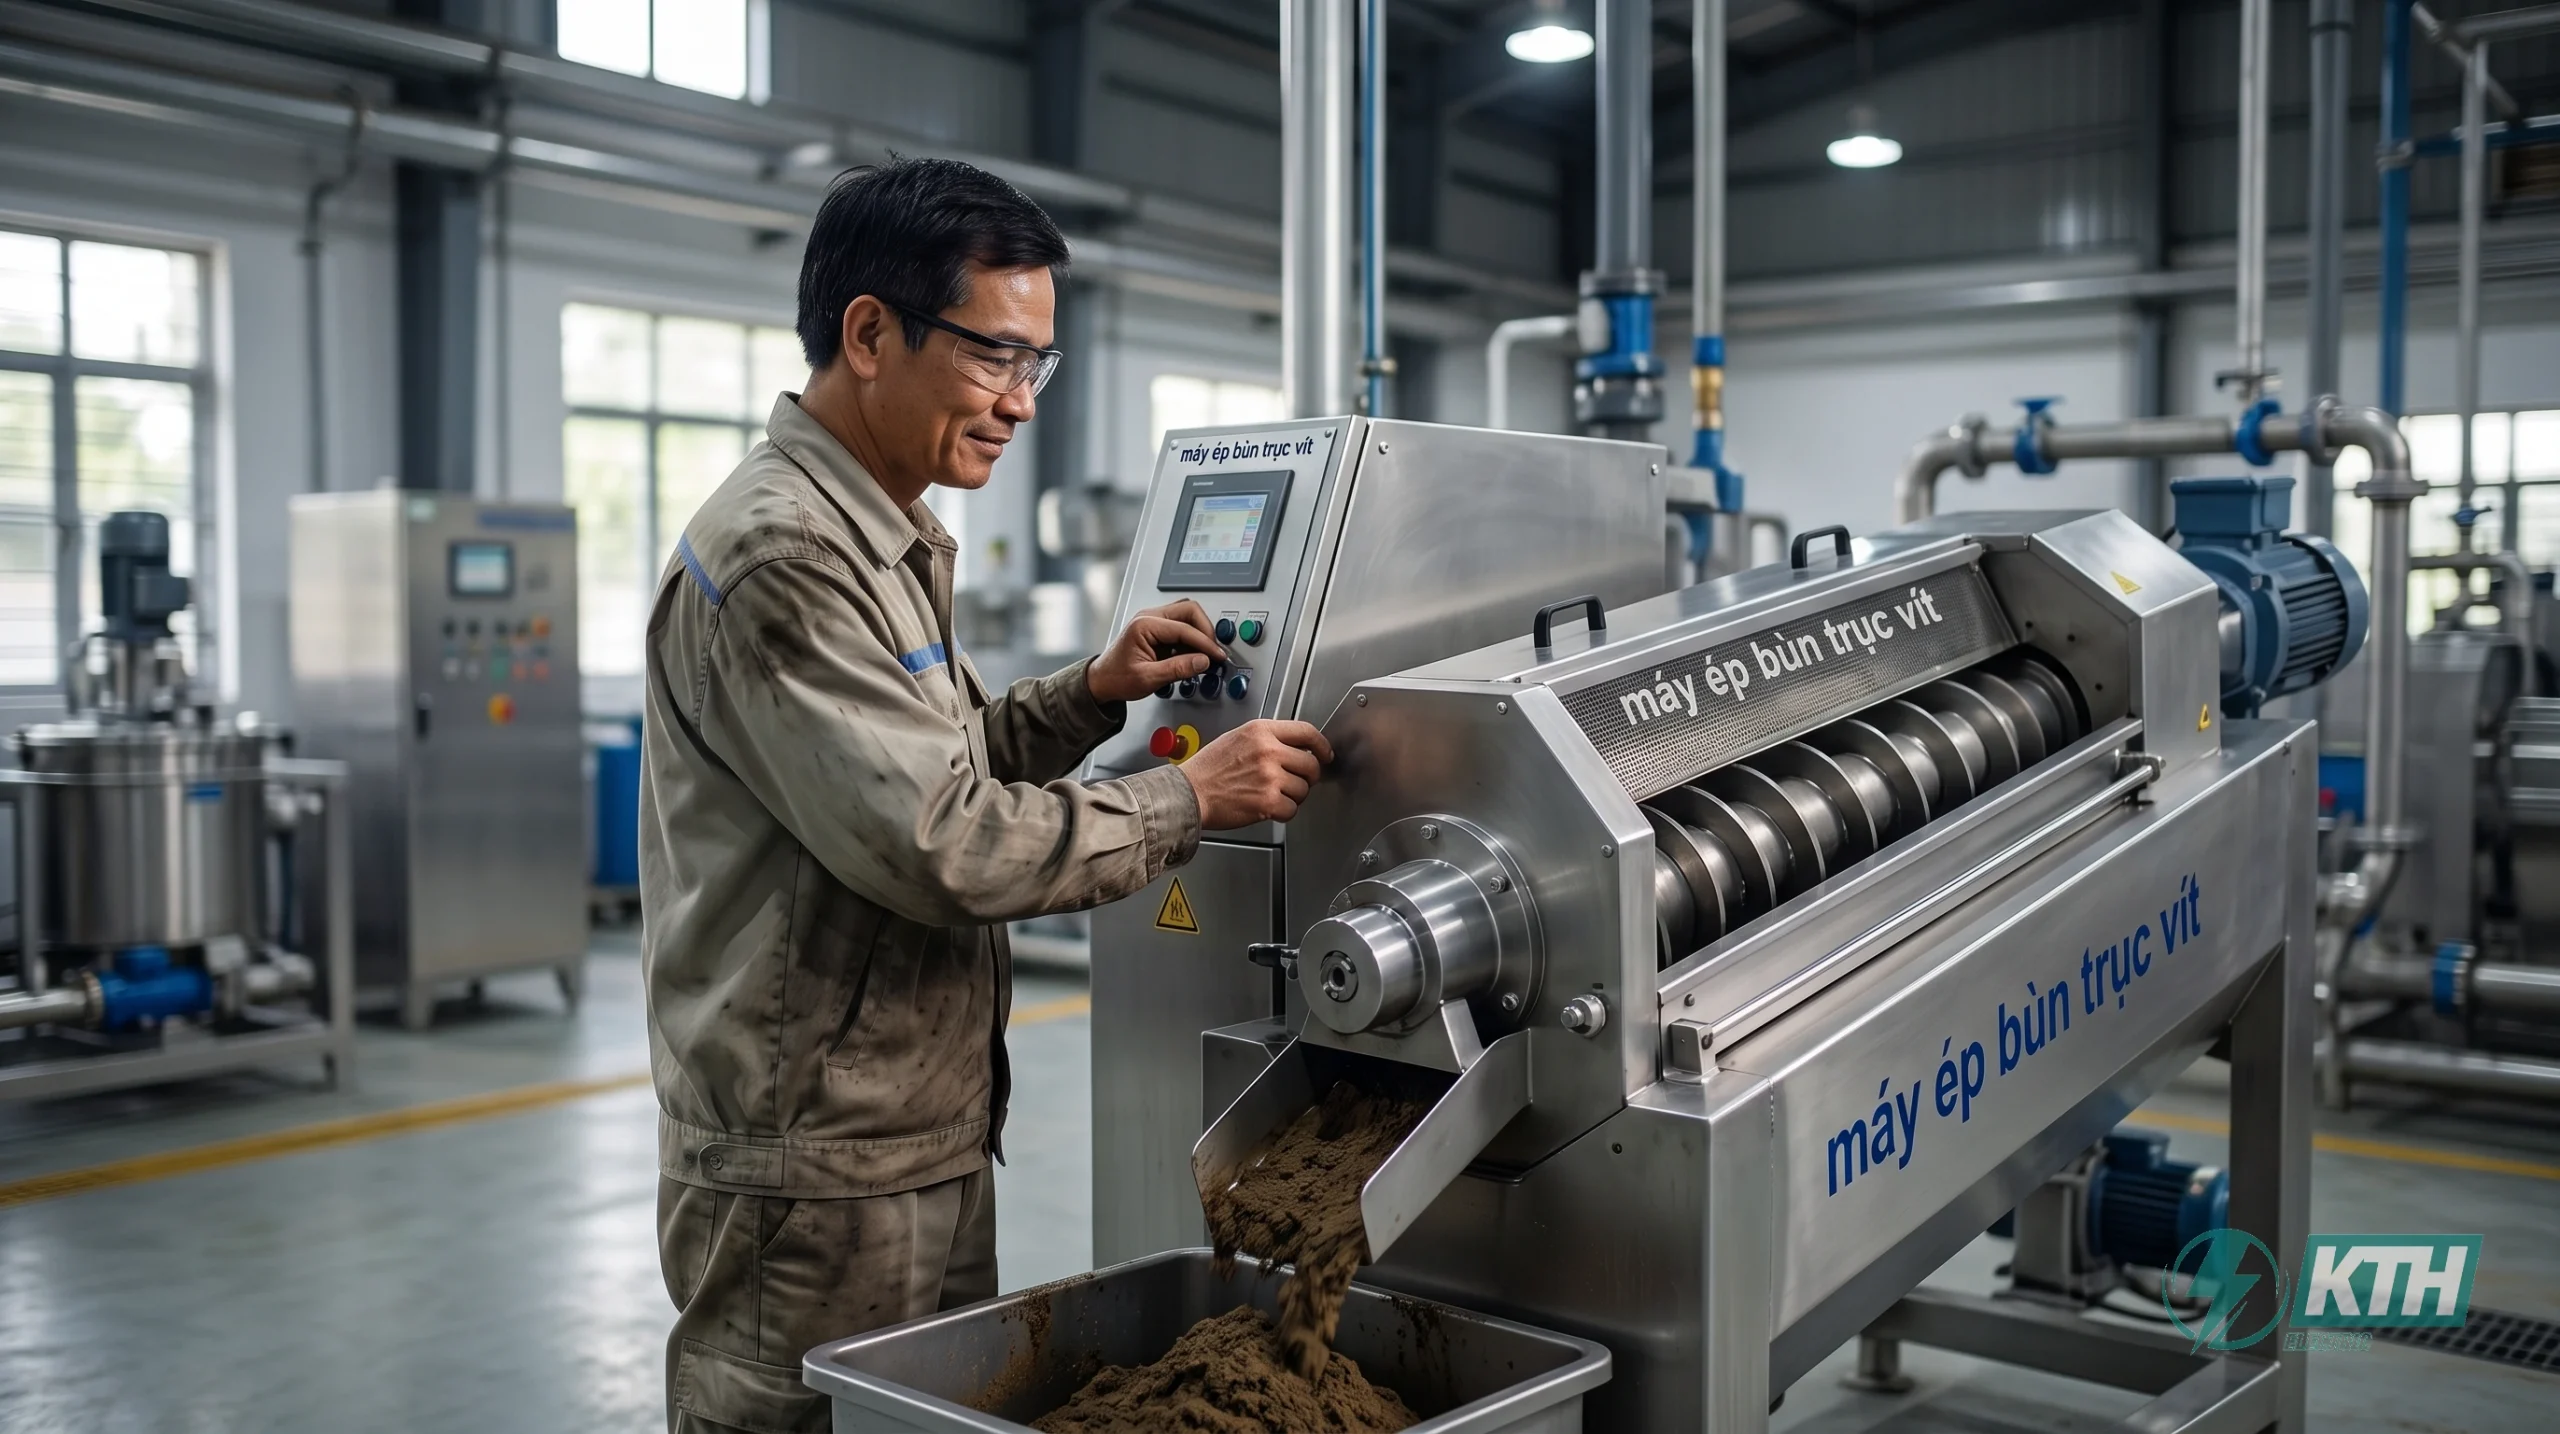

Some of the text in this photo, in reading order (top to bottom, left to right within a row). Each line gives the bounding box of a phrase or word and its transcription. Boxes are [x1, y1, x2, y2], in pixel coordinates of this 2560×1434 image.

[1180, 436, 1314, 466] máy ép bùn trục vít
[1619, 587, 1943, 726] máy ép bùn trục vít
[1827, 871, 2202, 1198] máy ép bùn trục vít
